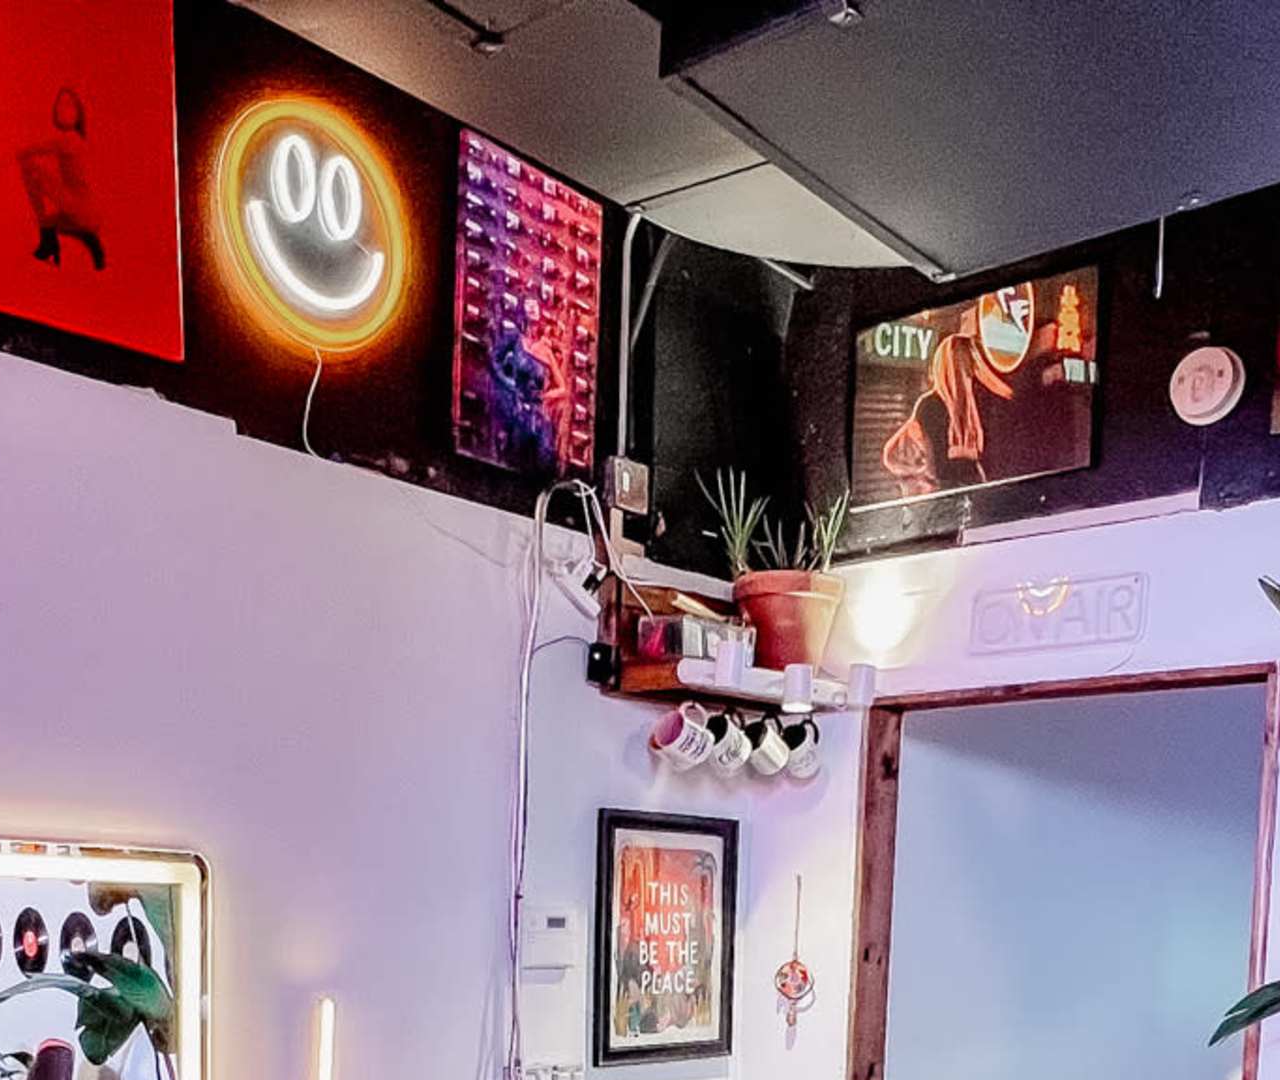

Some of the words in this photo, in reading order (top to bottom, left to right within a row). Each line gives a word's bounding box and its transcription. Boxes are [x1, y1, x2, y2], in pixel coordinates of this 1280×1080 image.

[874, 322, 933, 361] CITY
[1060, 586, 1134, 637] AIR
[648, 881, 689, 906] THIS
[645, 911, 692, 936] MUST
[639, 940, 659, 965] BE
[666, 940, 699, 965] THE
[640, 970, 696, 995] PLACE
